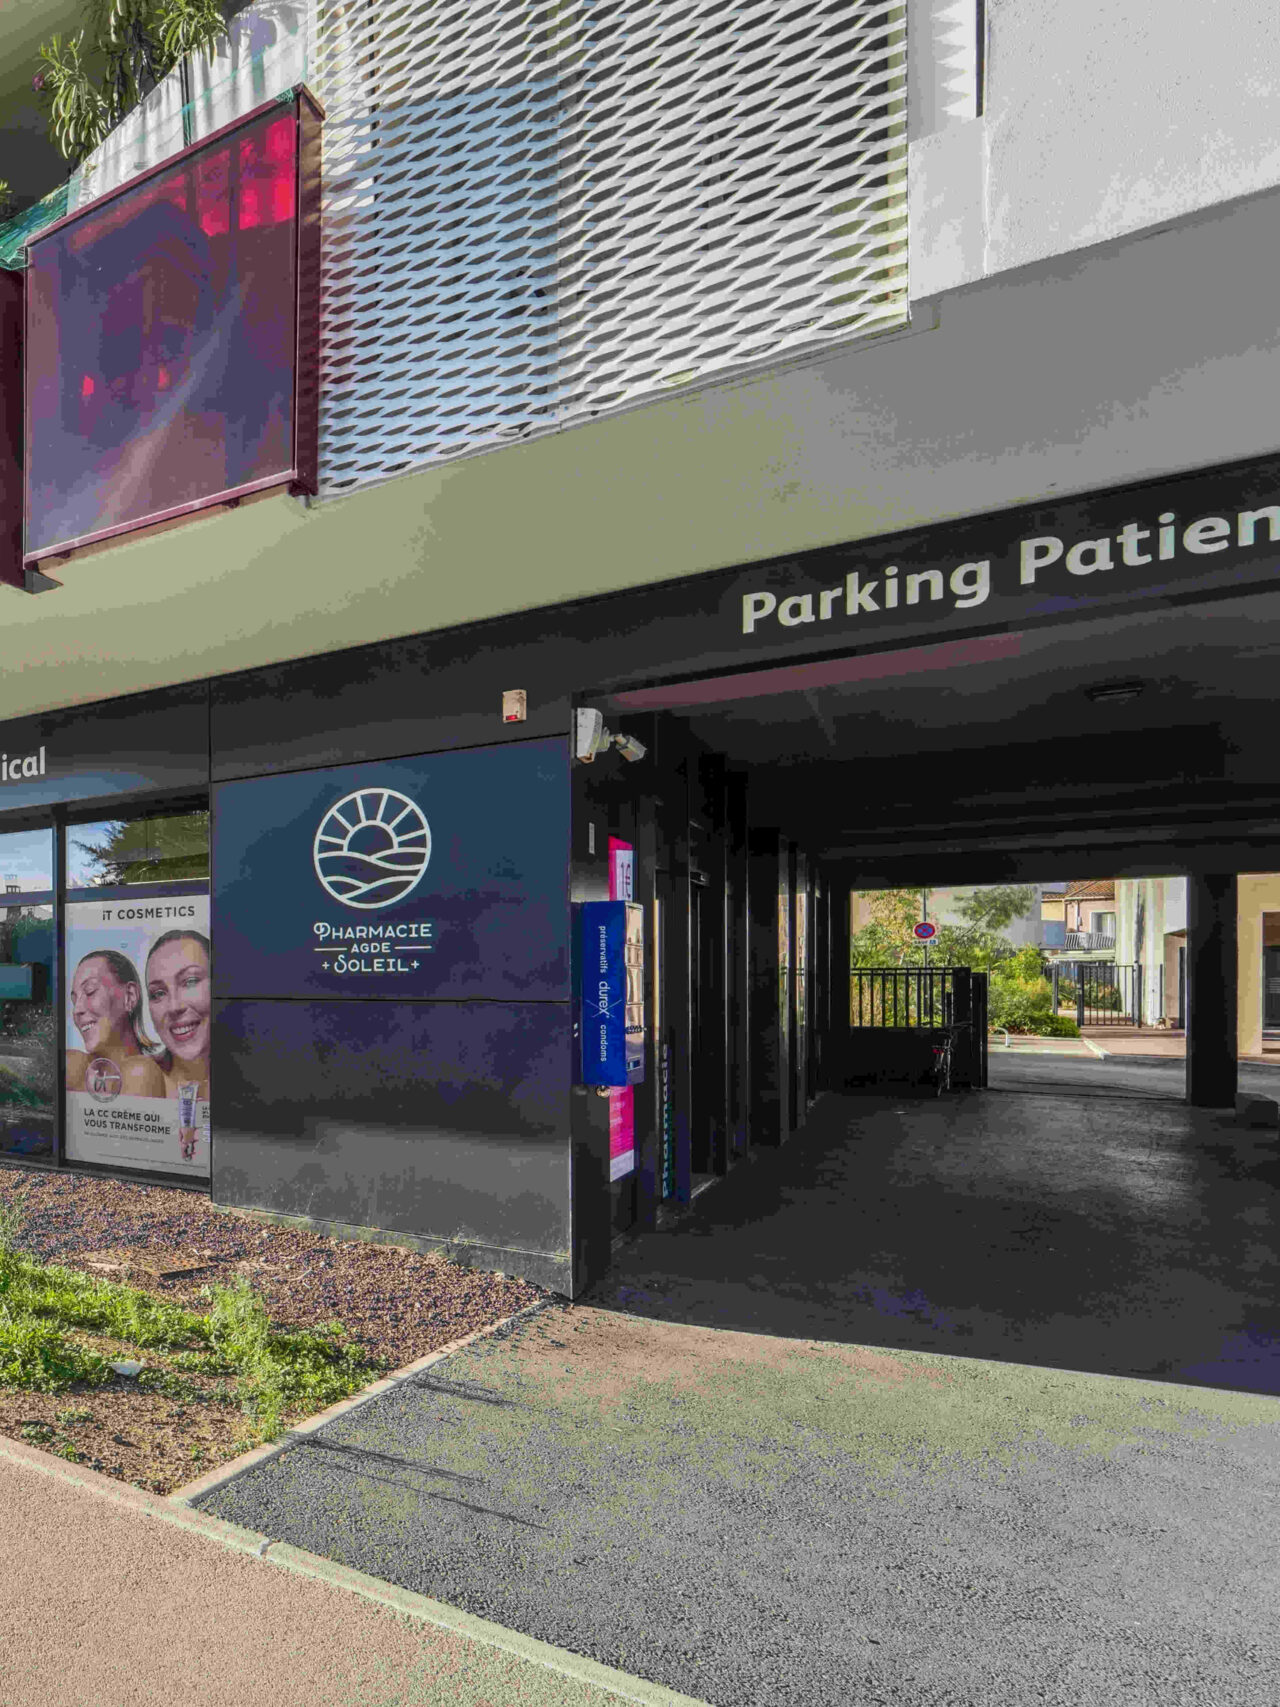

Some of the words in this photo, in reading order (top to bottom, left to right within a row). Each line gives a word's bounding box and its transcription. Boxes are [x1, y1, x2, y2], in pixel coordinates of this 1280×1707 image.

[742, 560, 991, 634] Parking
[1020, 504, 1280, 585] Patien
[117, 906, 195, 920] COSMETICS
[313, 922, 433, 941] PHARMACIE
[350, 942, 391, 953] AGDE
[598, 925, 609, 974] préservatifs
[333, 954, 410, 974] SOLEIL
[600, 1024, 609, 1062] condoms
[83, 1108, 95, 1117] LA
[97, 1109, 109, 1118] CC
[111, 1109, 141, 1121] CRÈME
[144, 1113, 161, 1123] QUI
[83, 1119, 108, 1129] VOUS
[109, 1121, 171, 1135] TRANSFORME
